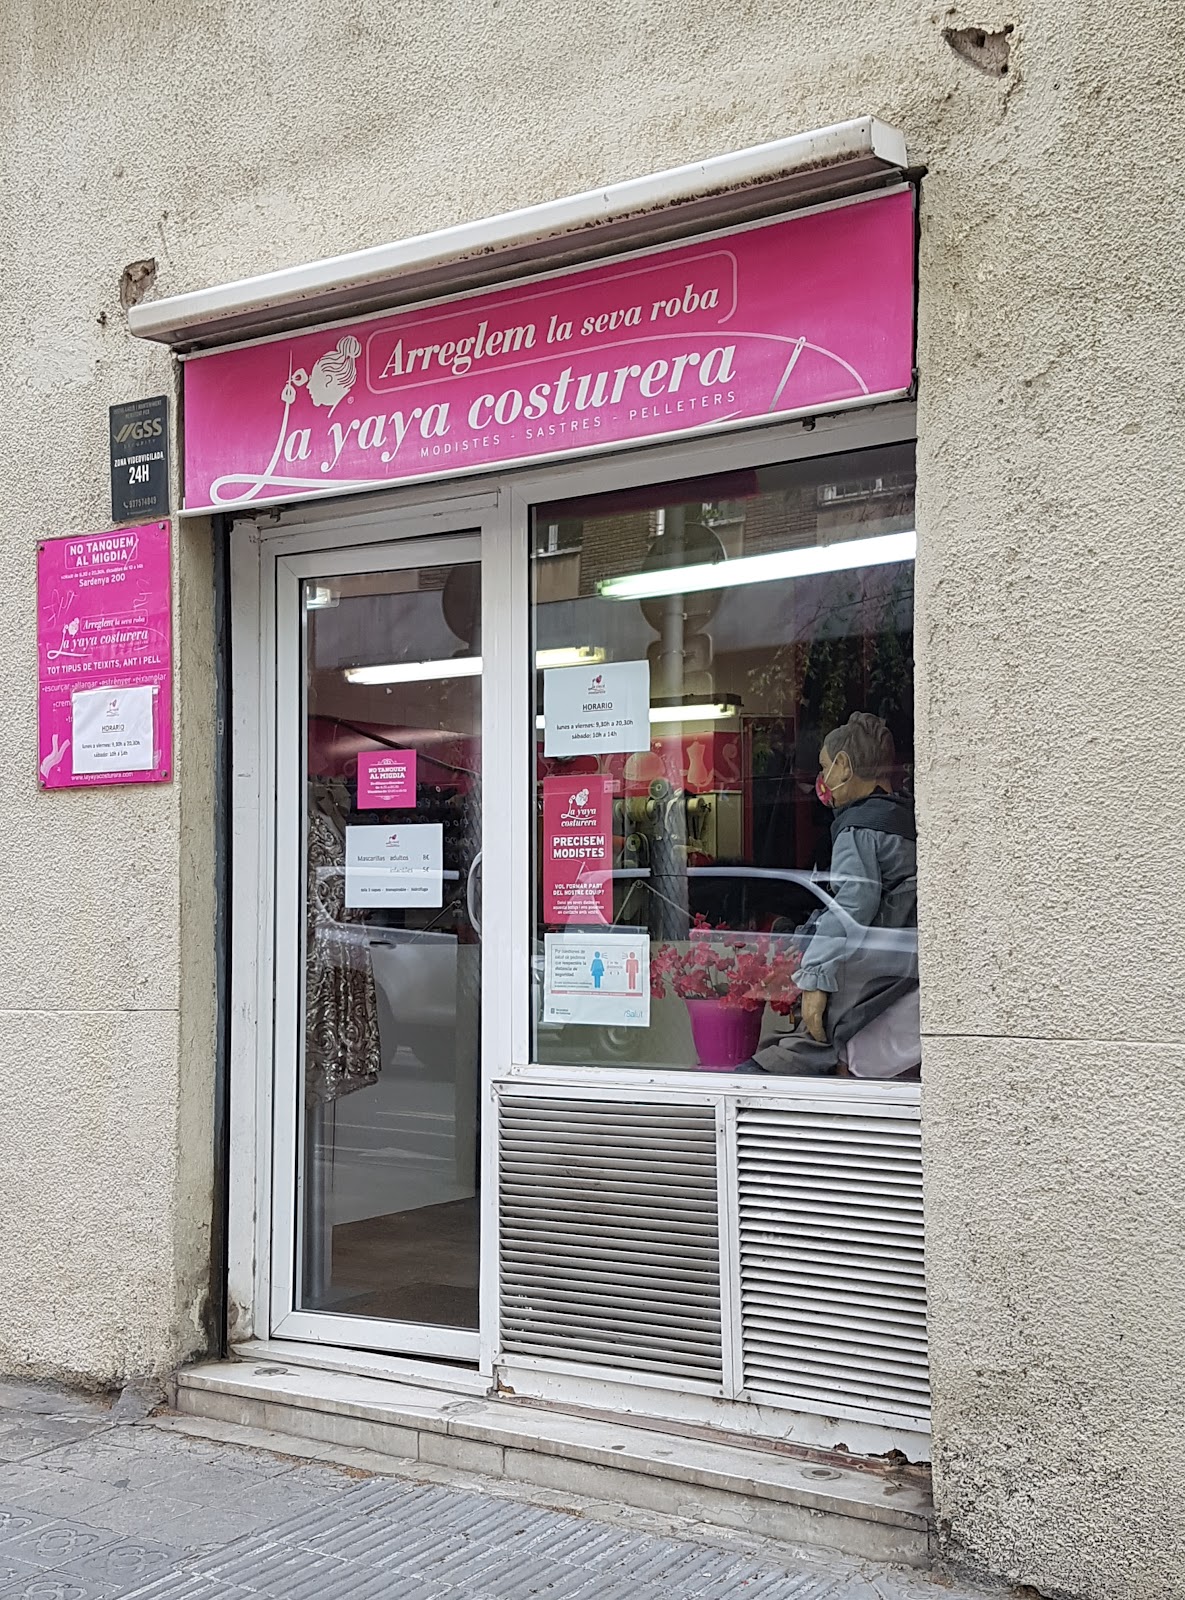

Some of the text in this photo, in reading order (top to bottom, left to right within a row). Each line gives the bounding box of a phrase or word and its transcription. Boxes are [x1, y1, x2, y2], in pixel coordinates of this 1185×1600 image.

[379, 283, 719, 379] Arreglem la seva roba
[320, 402, 450, 472] yaya
[468, 345, 736, 430] costurera
[131, 418, 162, 440] GSS
[421, 435, 500, 458] MODISTES
[526, 416, 601, 440] SASTRES
[629, 391, 736, 420] PELLETERS
[114, 451, 164, 467] ZONA VIDEOVIGILADA
[128, 464, 149, 484] 24H
[70, 536, 134, 556] NO TANQUEM
[76, 550, 128, 567] AL MIGDIA
[79, 573, 126, 588] Sardenya 200
[83, 618, 114, 630] Arreglem
[70, 636, 98, 652] yaya
[100, 630, 148, 644] costurera
[47, 666, 60, 675] TOT
[62, 663, 81, 674] TIPUS
[83, 663, 92, 671] DE
[93, 660, 122, 670] TEIXITS,
[123, 657, 137, 667] ANT
[143, 655, 161, 664] PELL
[582, 702, 613, 711] HORARIO
[102, 724, 125, 732] HORARIO
[576, 808, 597, 818] yaya
[561, 819, 597, 827] costurera
[553, 836, 604, 846] PRECISEM
[553, 848, 604, 858] MODISTES
